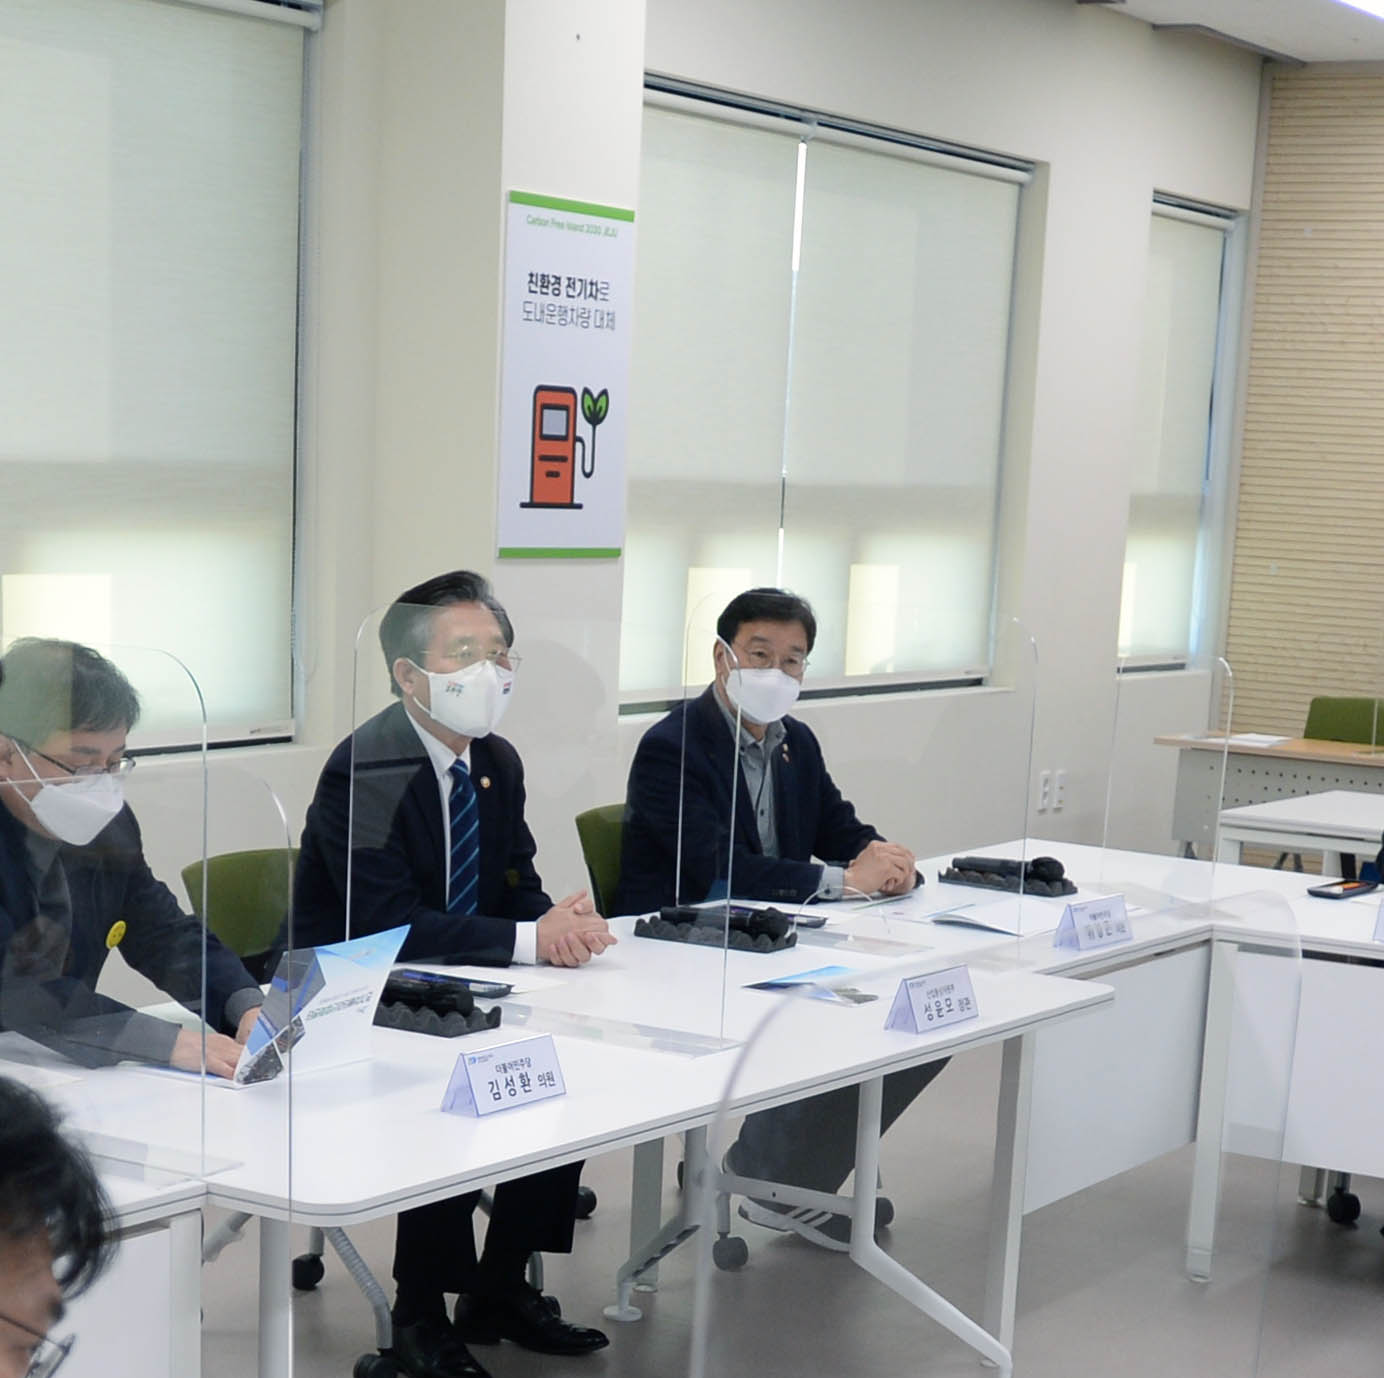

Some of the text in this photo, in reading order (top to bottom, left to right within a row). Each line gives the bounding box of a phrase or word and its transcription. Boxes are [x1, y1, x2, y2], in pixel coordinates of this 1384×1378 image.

[527, 271, 610, 302] 친환경 전기차로
[522, 300, 591, 329] 도내운행차량
[924, 997, 954, 1021] 성윤모
[488, 1071, 557, 1101] 김성환 의원
